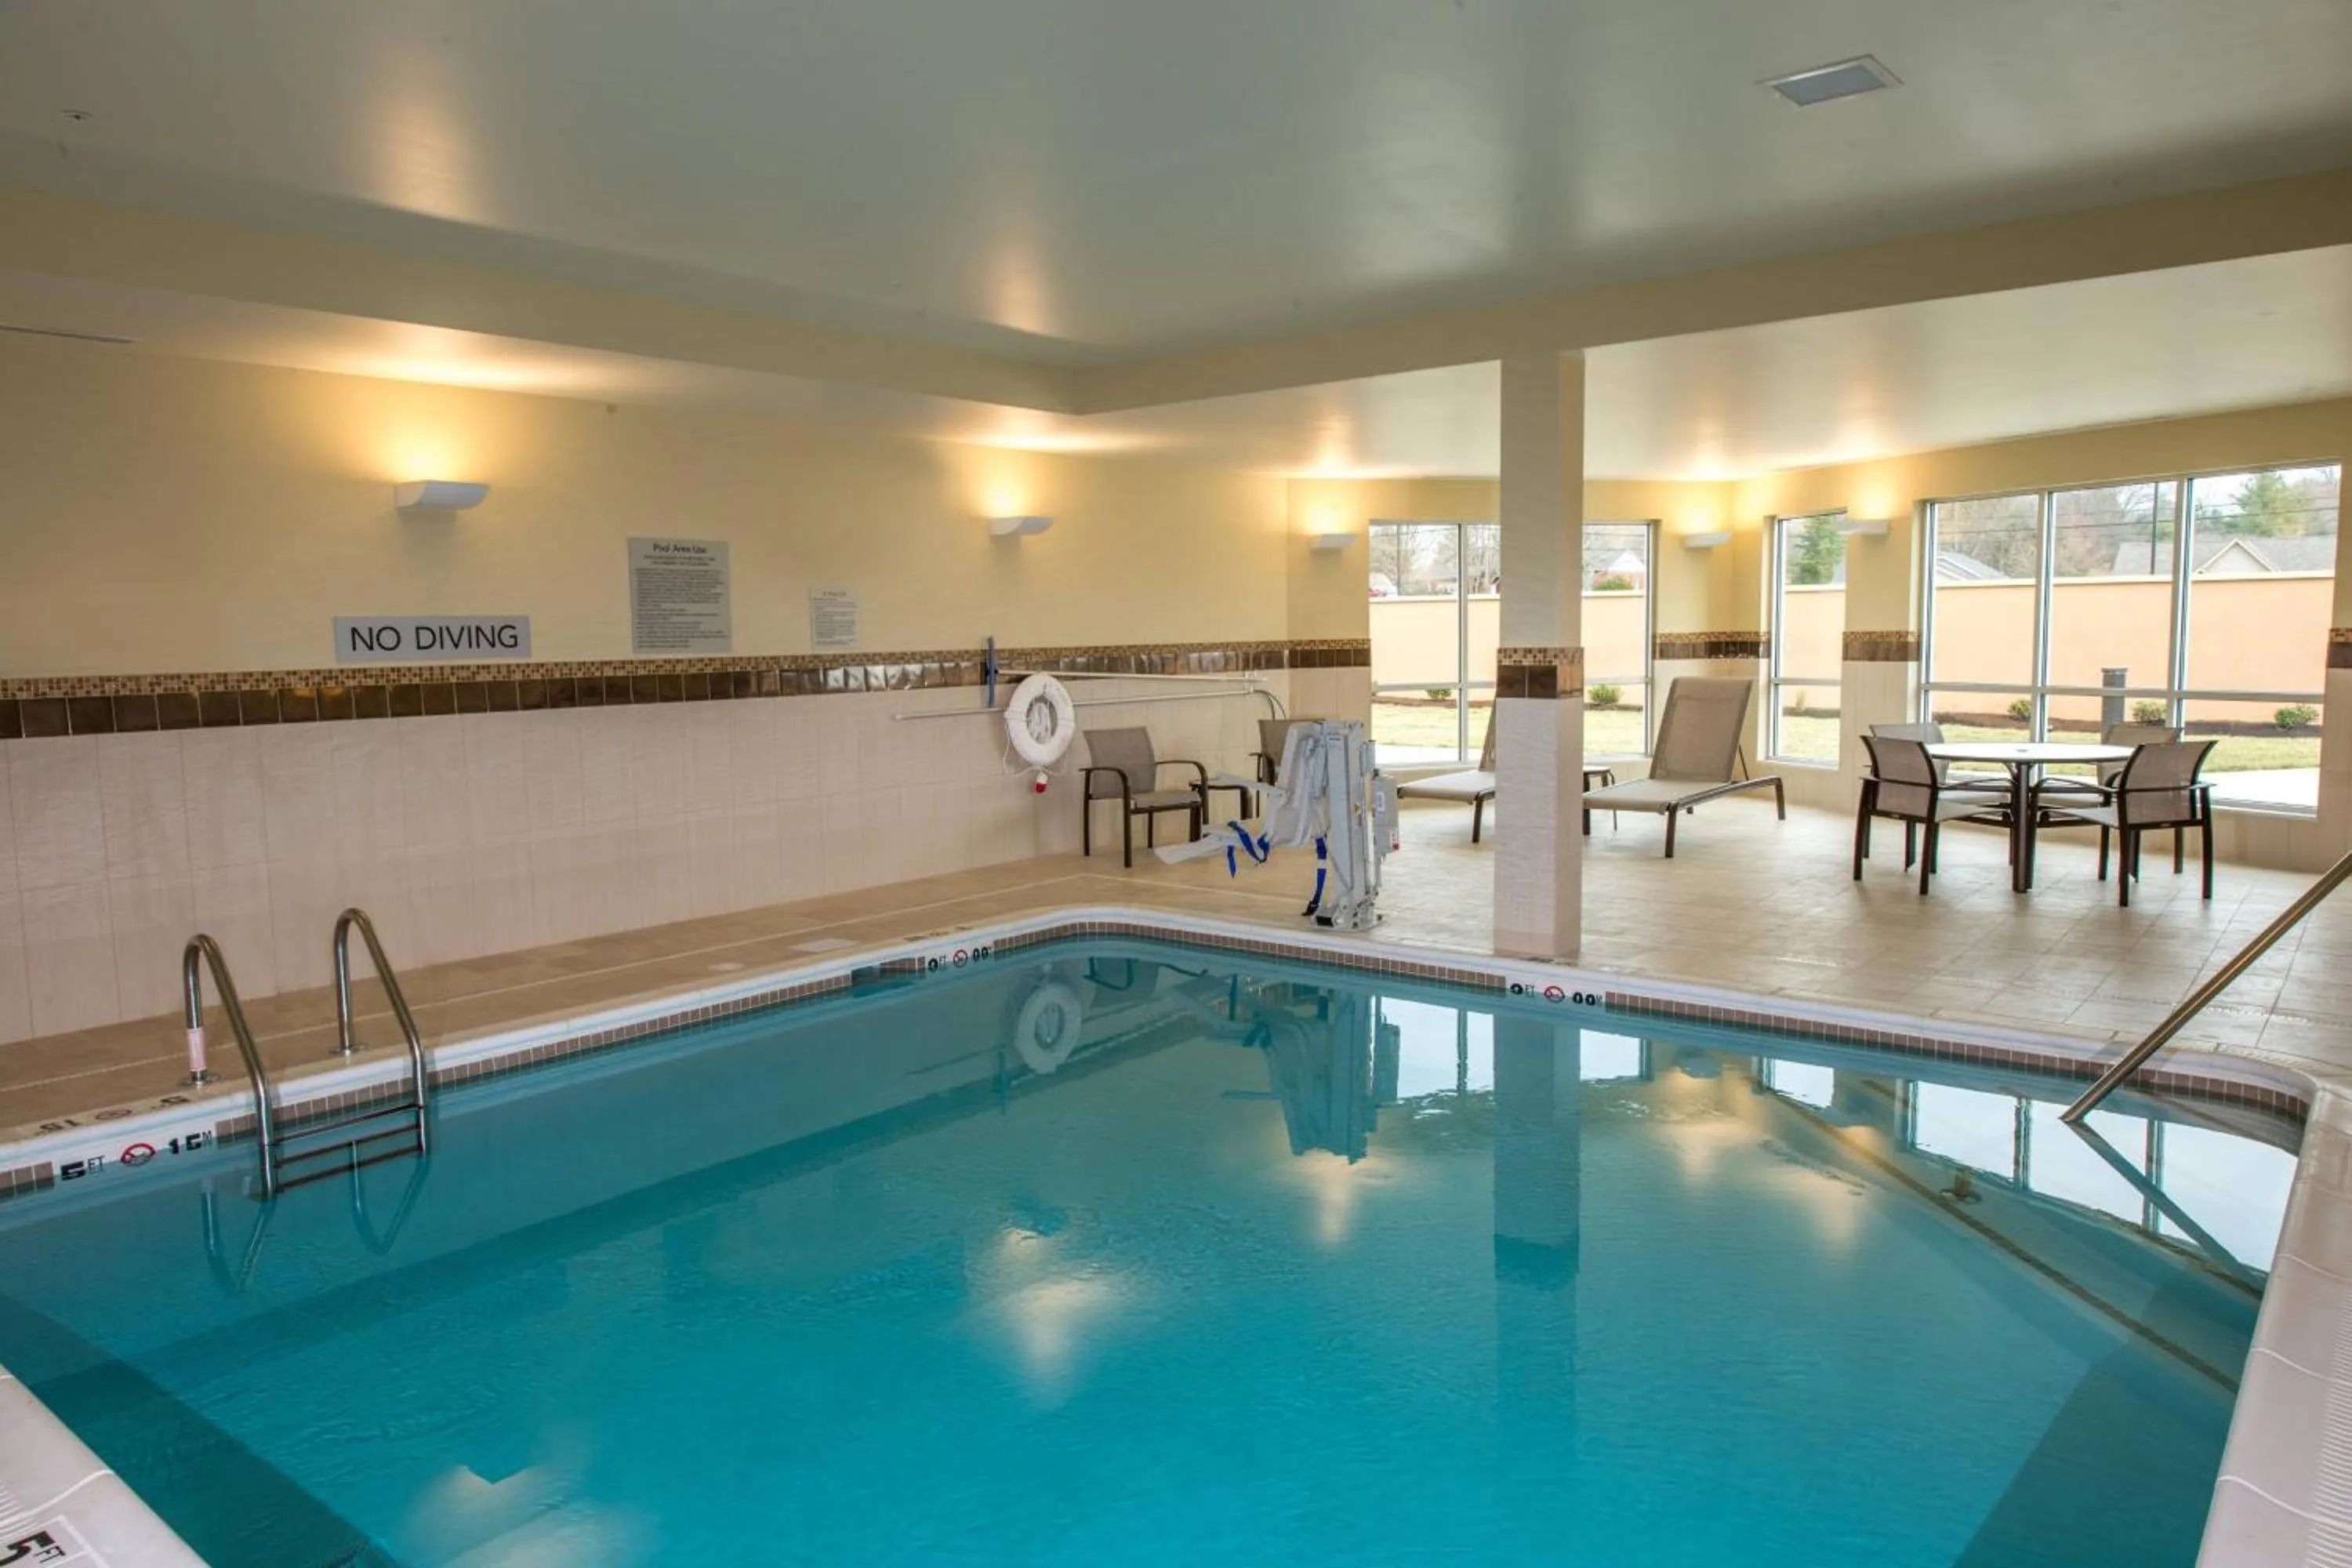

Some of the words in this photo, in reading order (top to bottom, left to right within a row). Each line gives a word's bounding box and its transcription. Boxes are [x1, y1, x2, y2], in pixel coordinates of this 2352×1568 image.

[673, 543, 691, 554] Area
[350, 625, 401, 652] NO
[415, 624, 519, 650] DIVING
